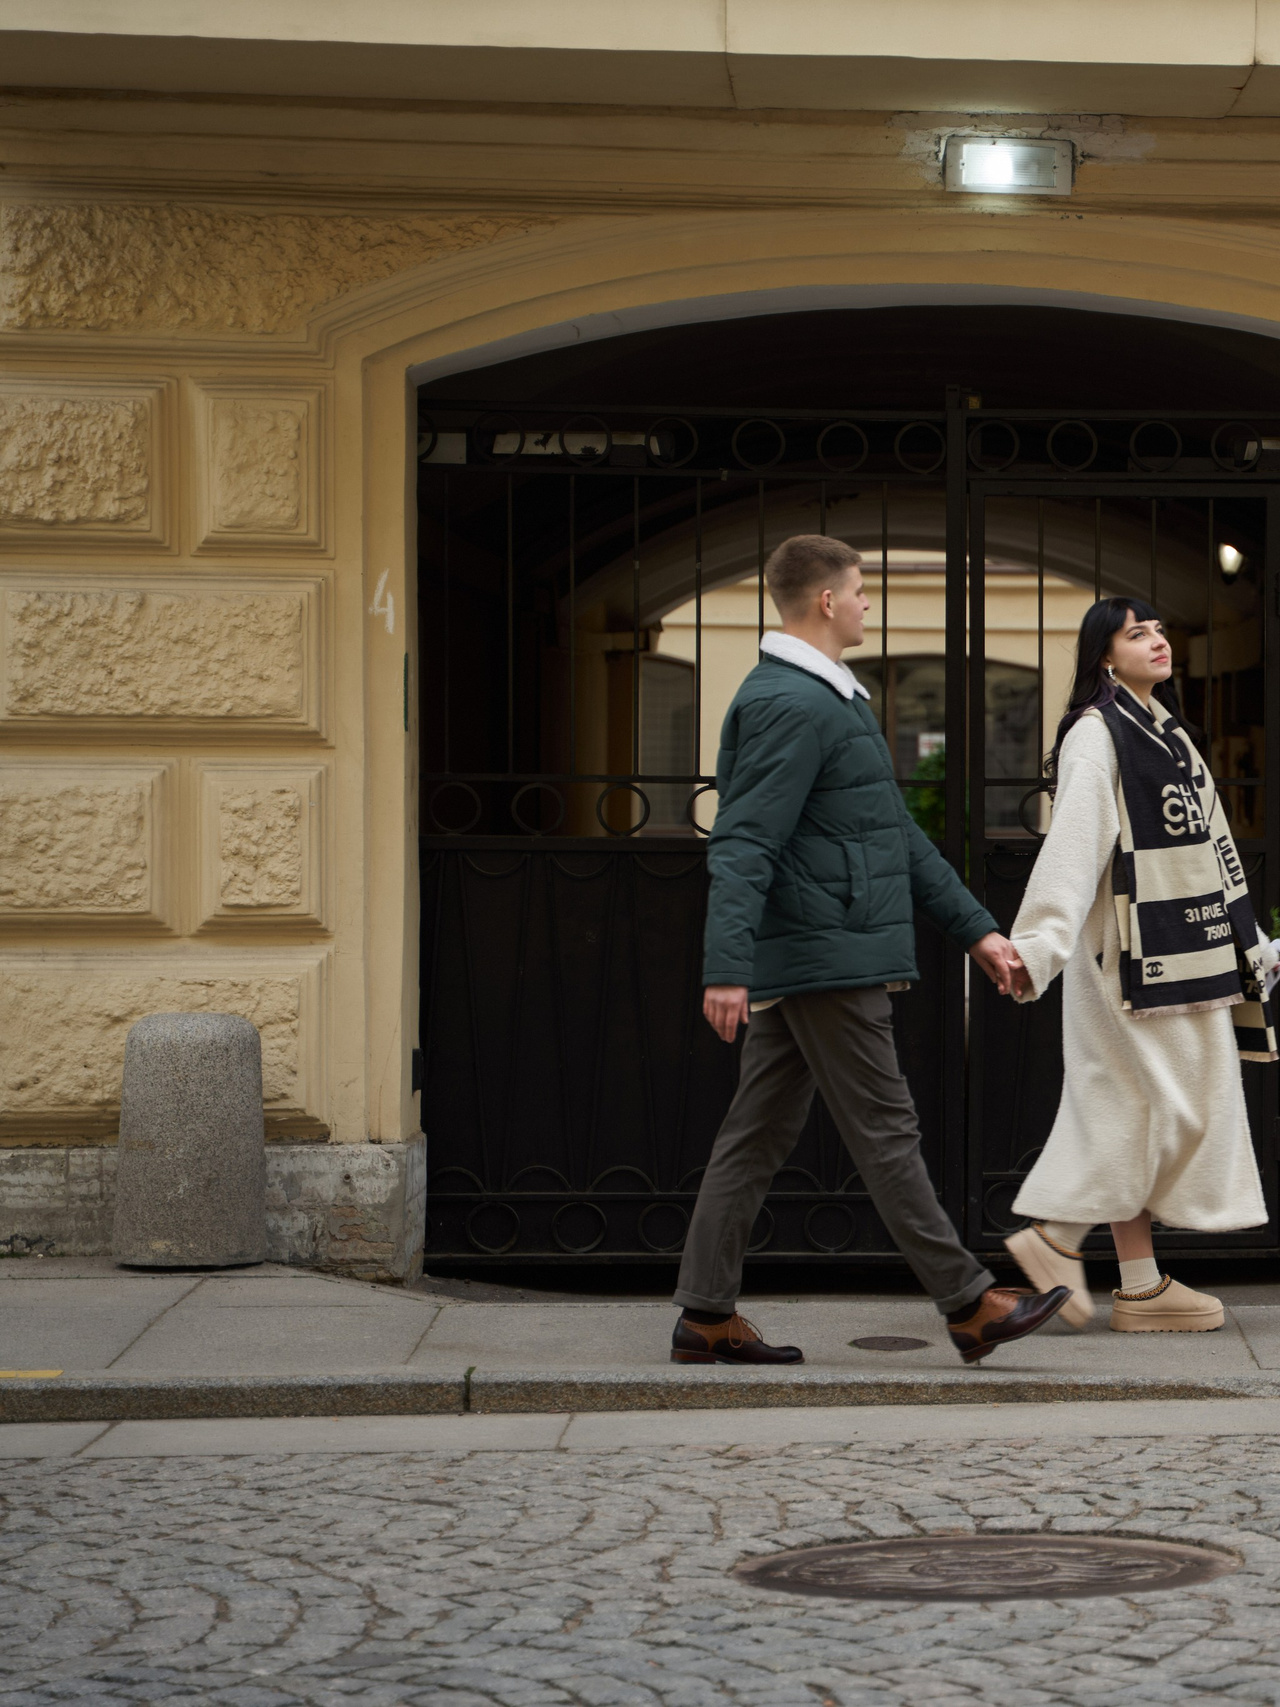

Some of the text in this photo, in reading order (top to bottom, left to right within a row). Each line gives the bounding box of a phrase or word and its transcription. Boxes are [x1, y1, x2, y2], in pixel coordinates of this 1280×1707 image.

[368, 567, 395, 635] 4
[1184, 907, 1201, 923] 31
[1201, 902, 1225, 921] RUE
[1204, 922, 1232, 941] 75001
